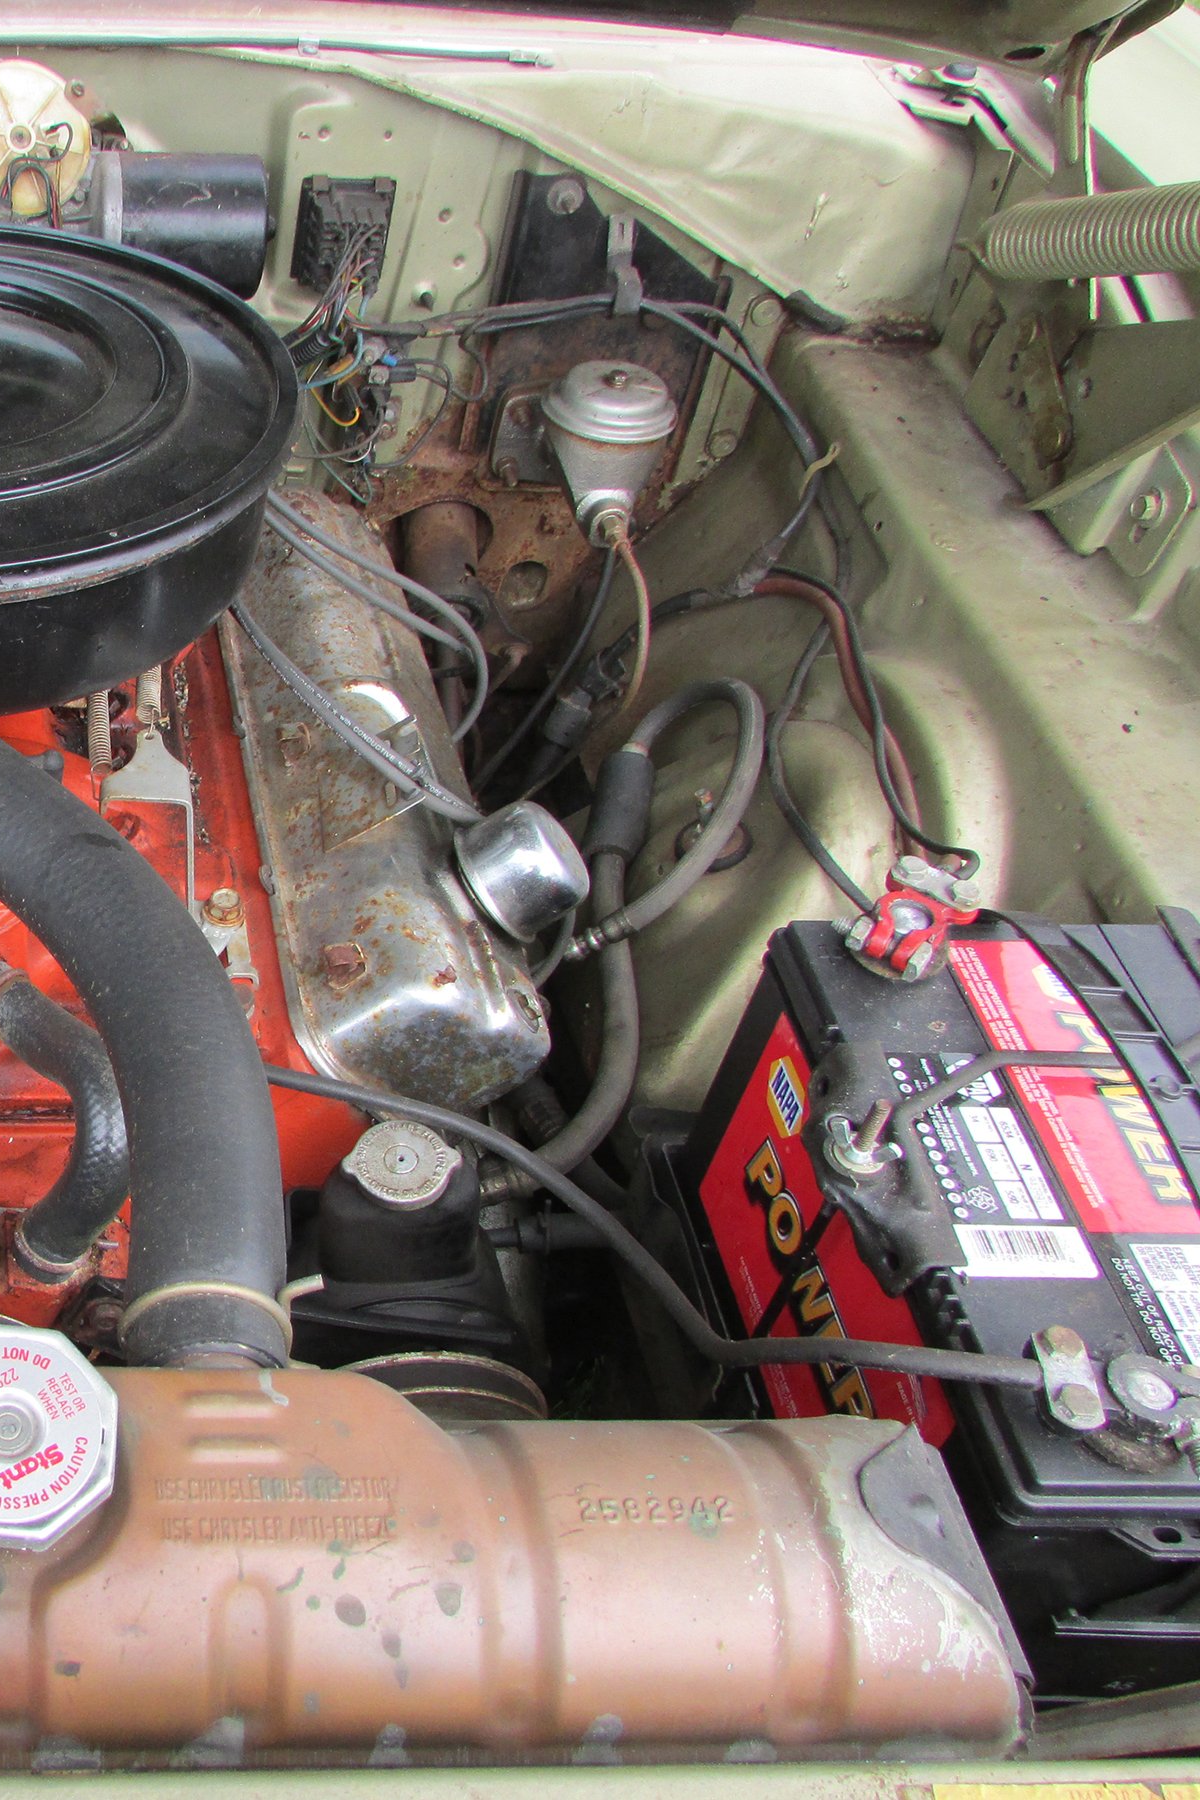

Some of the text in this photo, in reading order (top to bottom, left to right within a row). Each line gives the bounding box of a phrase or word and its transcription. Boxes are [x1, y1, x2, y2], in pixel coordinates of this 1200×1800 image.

[353, 726, 396, 764] CONDUCTIVE
[964, 947, 990, 979] CALIFORNIA
[981, 980, 1011, 1018] PROPOSITION
[770, 1063, 801, 1132] NAPA
[1161, 1246, 1182, 1269] GASES
[1171, 1246, 1200, 1285] EXPLOSIVE
[1111, 1257, 1125, 1272] DO
[1119, 1272, 1136, 1291] NOT
[1139, 1310, 1153, 1325] DO
[1148, 1326, 1165, 1346] NOT
[1158, 1347, 1176, 1367] OPE
[1121, 1258, 1140, 1280] KEEP
[1136, 1283, 1152, 1302] OUT
[1146, 1304, 1159, 1319] OF
[1154, 1319, 1178, 1356] REACH
[1, 1346, 30, 1362] NOT
[32, 1355, 52, 1370] DO
[37, 1389, 61, 1421] WHEN
[45, 1377, 76, 1420] REPLACE
[58, 1372, 87, 1412] TEST OR
[0, 1443, 65, 1490] Stant
[49, 1436, 88, 1494] CAUTION
[198, 1516, 280, 1542] CHRYSLER
[576, 1495, 735, 1526] 2582942
